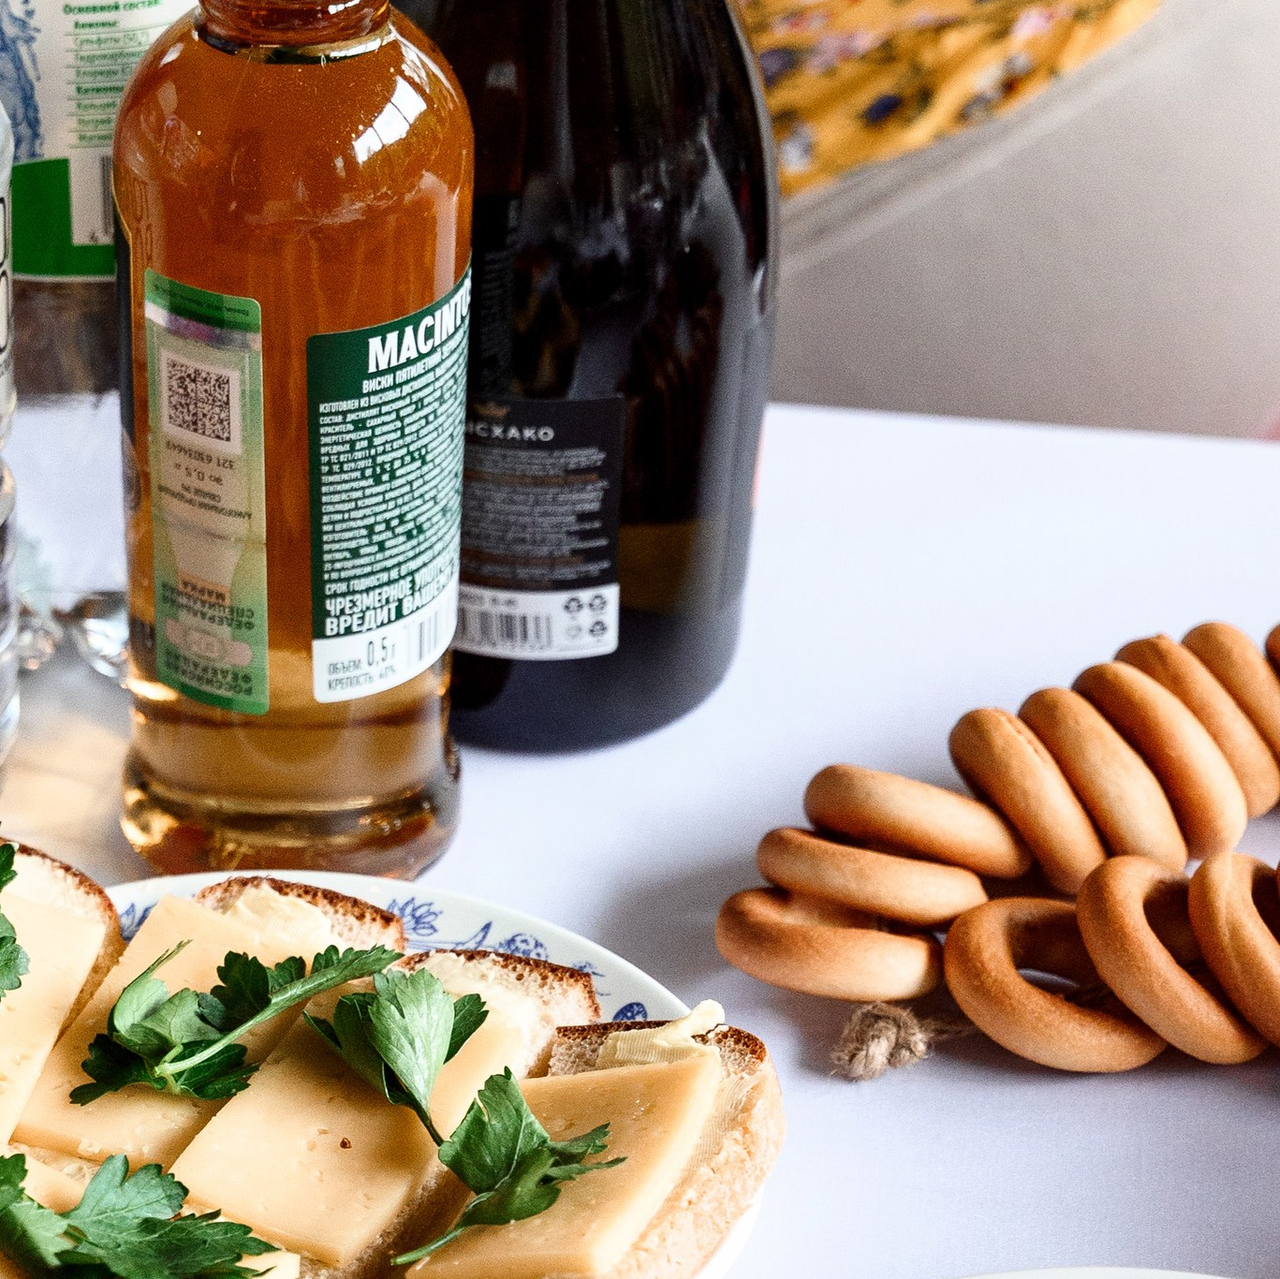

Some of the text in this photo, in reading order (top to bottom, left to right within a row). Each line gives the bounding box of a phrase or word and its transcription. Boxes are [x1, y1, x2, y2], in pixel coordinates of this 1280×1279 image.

[362, 373, 394, 393] ВИСКИ
[319, 398, 359, 414] ИЗГОТОВЛЕН
[360, 397, 368, 408] ИЗ
[319, 414, 344, 424] СОСТАВ:
[319, 422, 354, 434] КРАСИТЕЛЬ
[320, 429, 372, 444] ЭНЕРГЕТИЧЕСКАЯ
[320, 444, 350, 455] ВРЕДНЫХ
[355, 439, 368, 450] ДЛЯ
[321, 454, 330, 464] ТР
[330, 453, 339, 463] ТС
[339, 450, 369, 462] 021/2011
[321, 464, 329, 473] ТР
[332, 463, 340, 472] ТС
[322, 471, 361, 484] ТЕМПЕРАТУРЕ
[324, 581, 348, 595] СРОК
[349, 571, 389, 590] ГОДНОСТИ
[325, 575, 413, 616] ЧРЕЗМЕРНОЕ
[325, 601, 399, 636] ВРЕДИТ
[367, 637, 389, 667] 0,5
[328, 672, 375, 691] КРЕПОСТЬ
